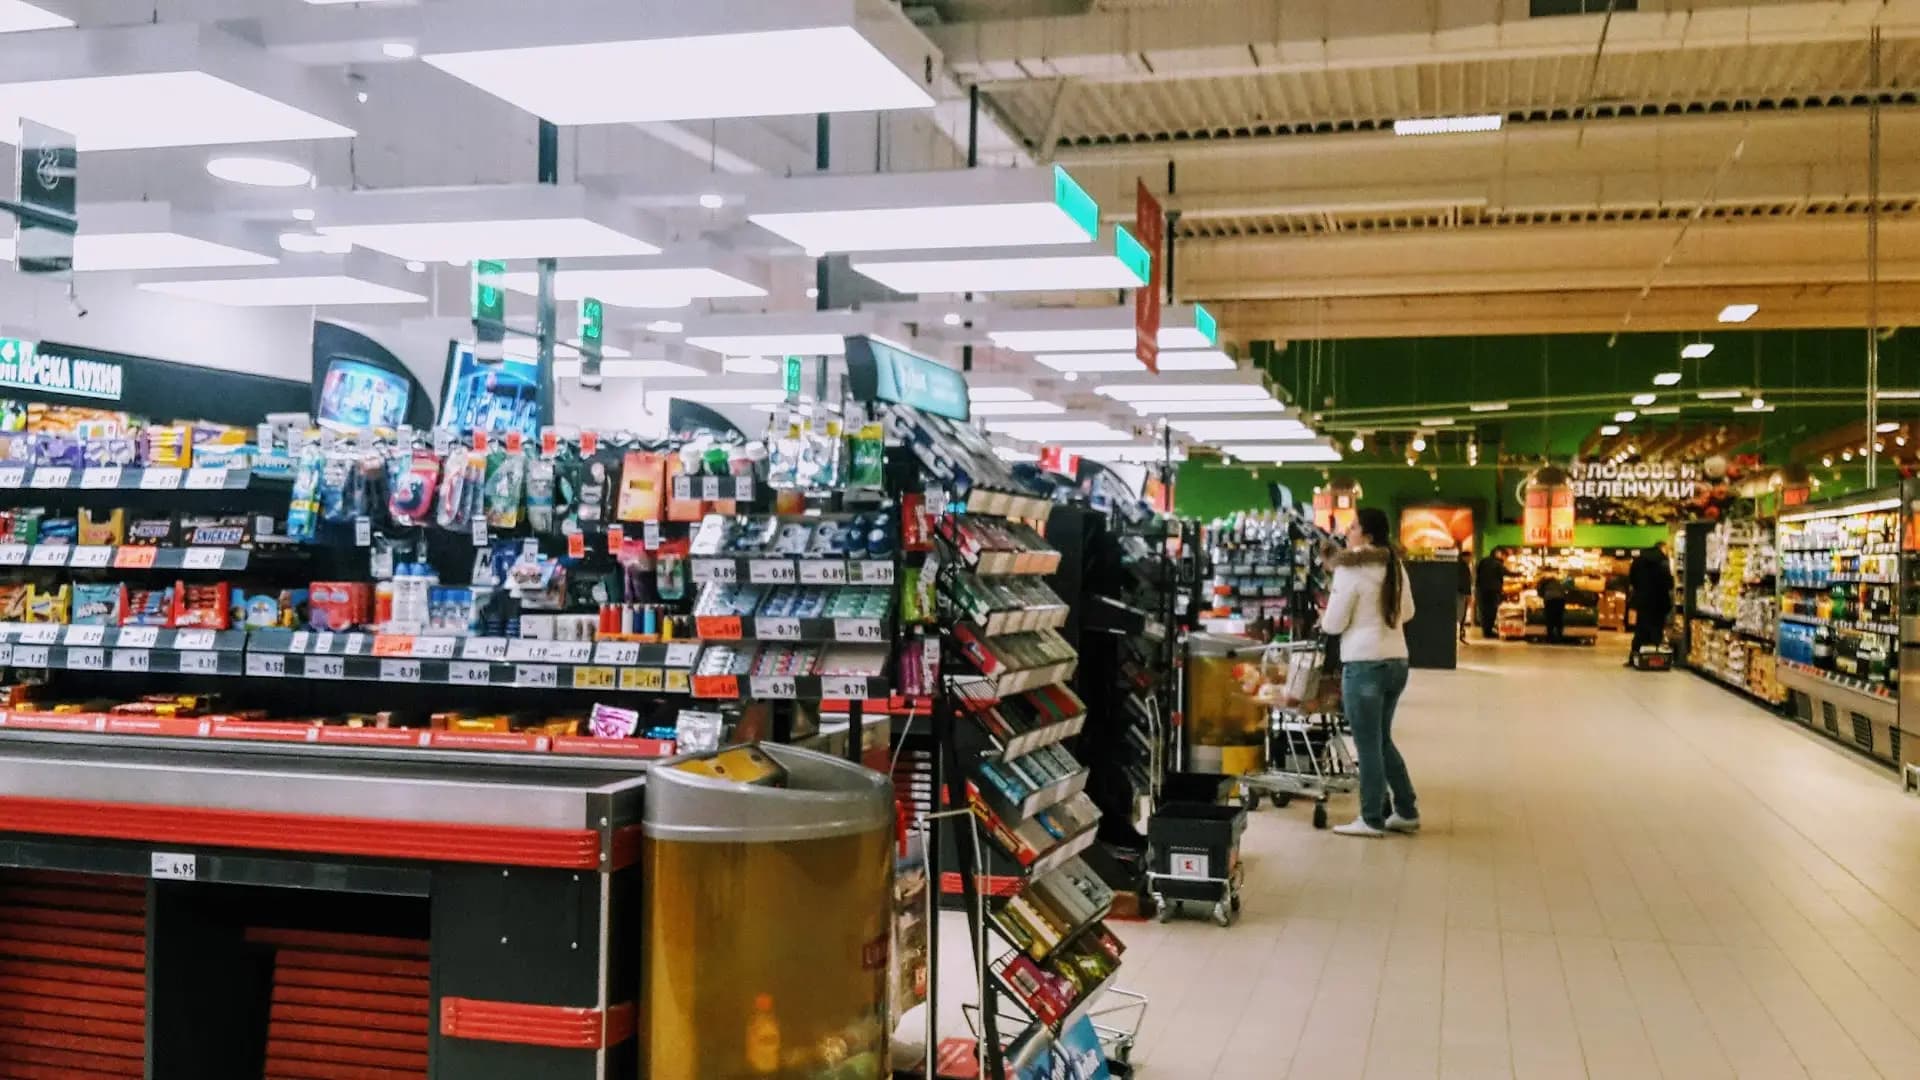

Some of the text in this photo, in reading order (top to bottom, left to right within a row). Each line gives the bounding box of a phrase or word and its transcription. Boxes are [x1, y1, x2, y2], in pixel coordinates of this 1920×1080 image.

[1573, 480, 1695, 499] ЗЕЛЕНЧУЦИ
[195, 527, 241, 543] SNICKERS
[714, 567, 736, 579] 0.89
[772, 567, 794, 579] 0.89
[823, 567, 844, 579] 0.89
[778, 624, 799, 636] 0.79
[858, 626, 880, 638] 0.79
[772, 682, 795, 694] 0.79
[845, 683, 866, 695] 0.79
[173, 862, 194, 874] 6.95
